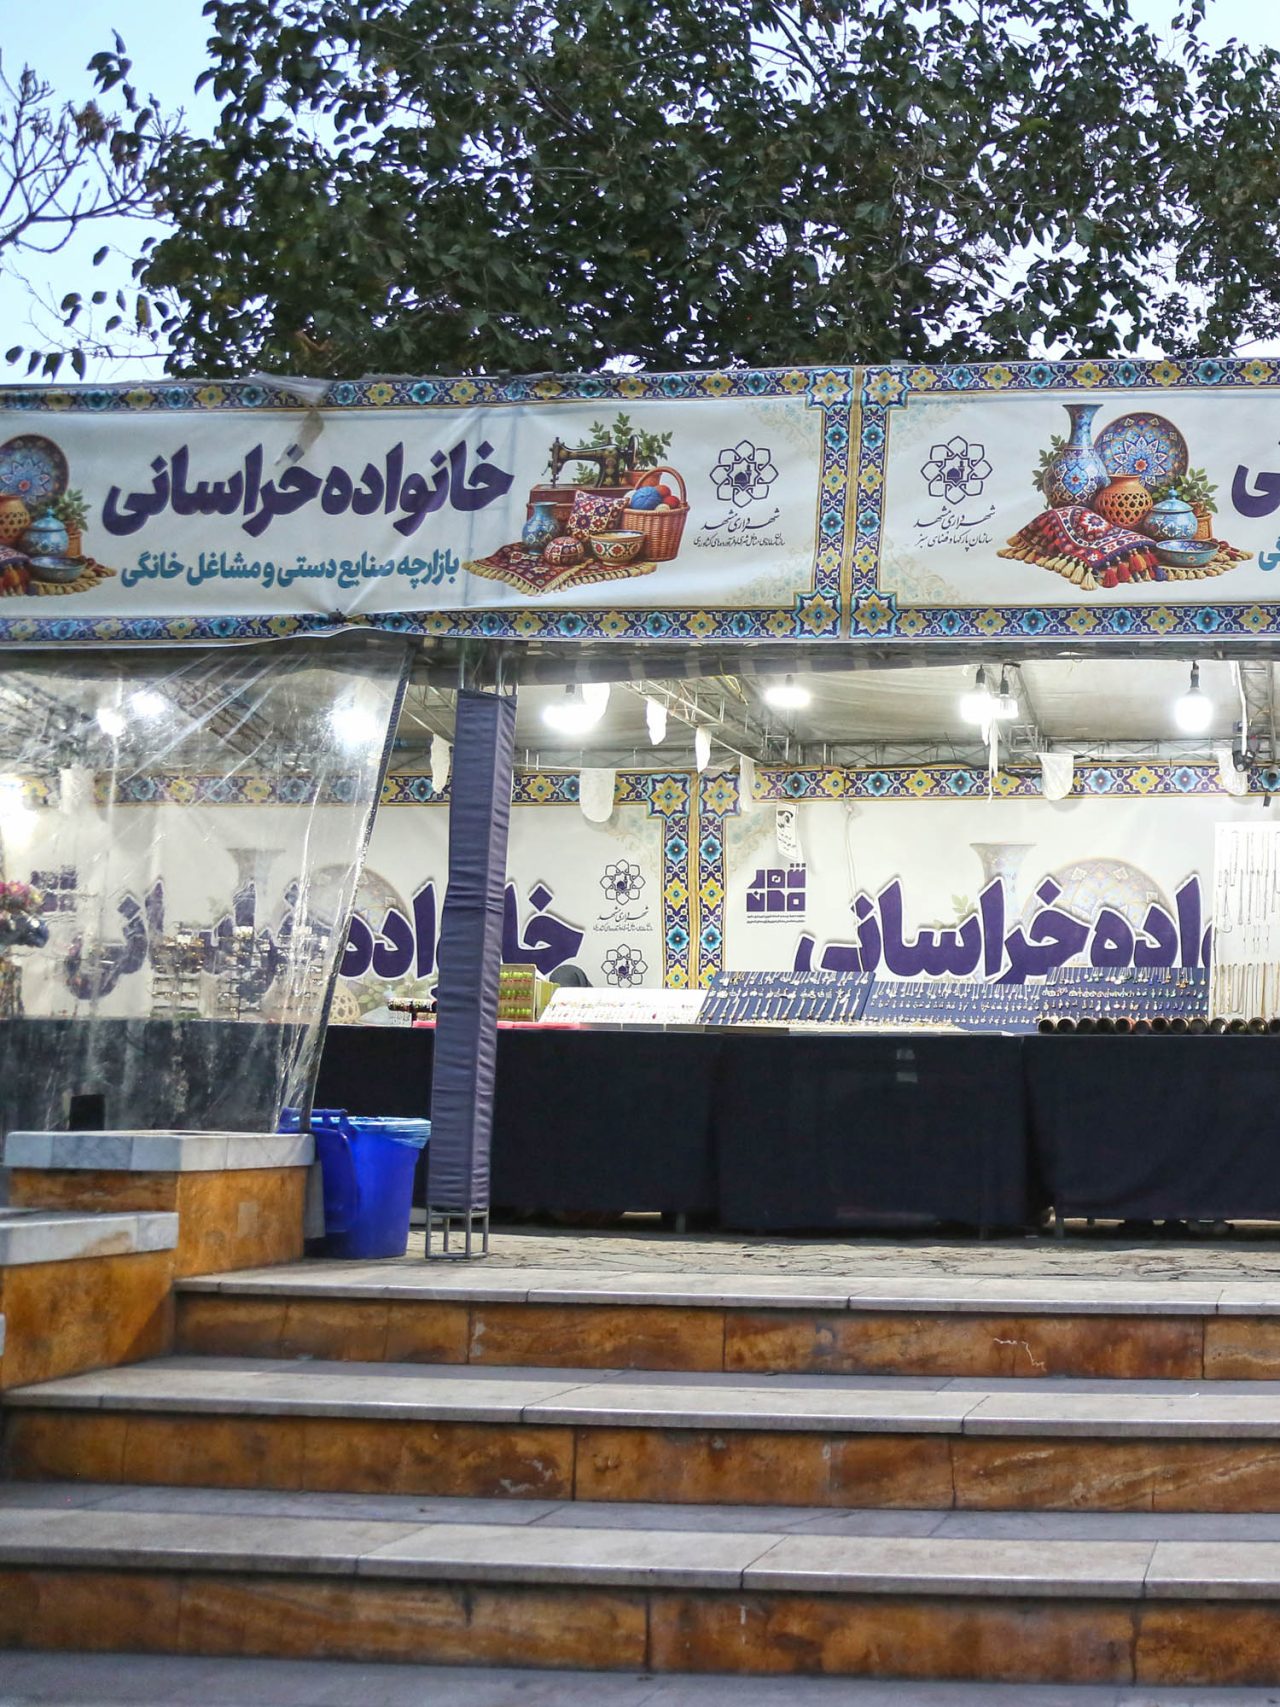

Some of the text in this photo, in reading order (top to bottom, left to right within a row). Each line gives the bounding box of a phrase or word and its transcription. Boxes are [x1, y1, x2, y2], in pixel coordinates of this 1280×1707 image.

[102, 440, 515, 538] خانواده خراسانی
[120, 548, 460, 590] بازارچه صنایع دستی و مشاغل خانگی
